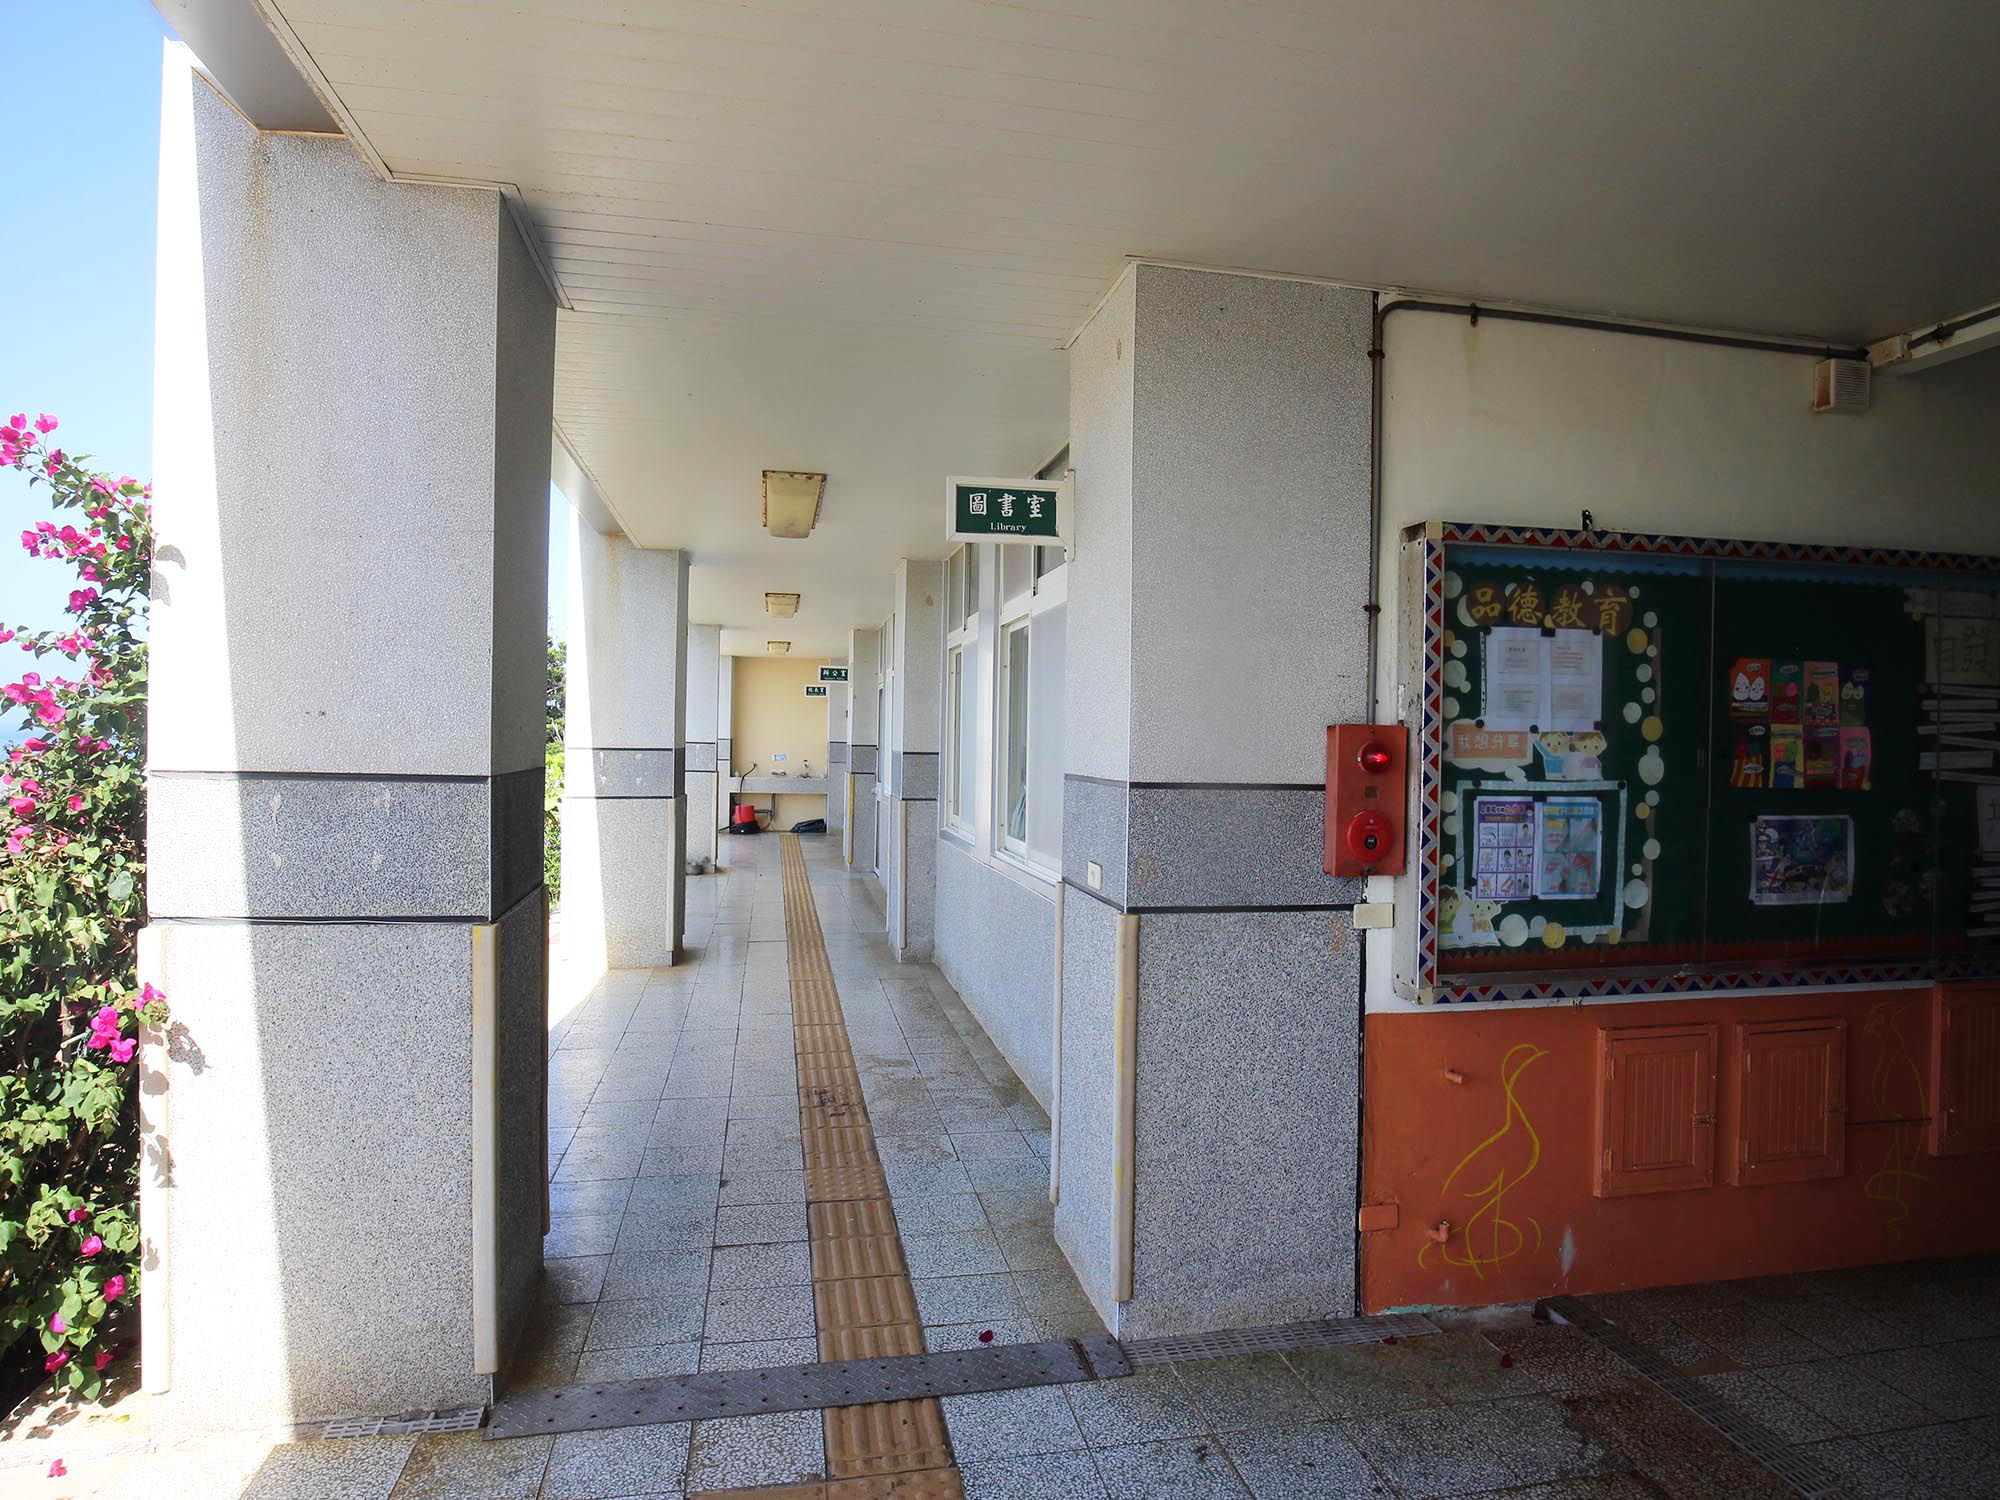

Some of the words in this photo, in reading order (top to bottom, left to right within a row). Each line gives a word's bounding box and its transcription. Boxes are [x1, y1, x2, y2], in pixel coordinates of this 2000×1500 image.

[969, 493, 1045, 518] 圖書室
[990, 522, 1027, 532] Library
[1471, 584, 1628, 636] 品德教育
